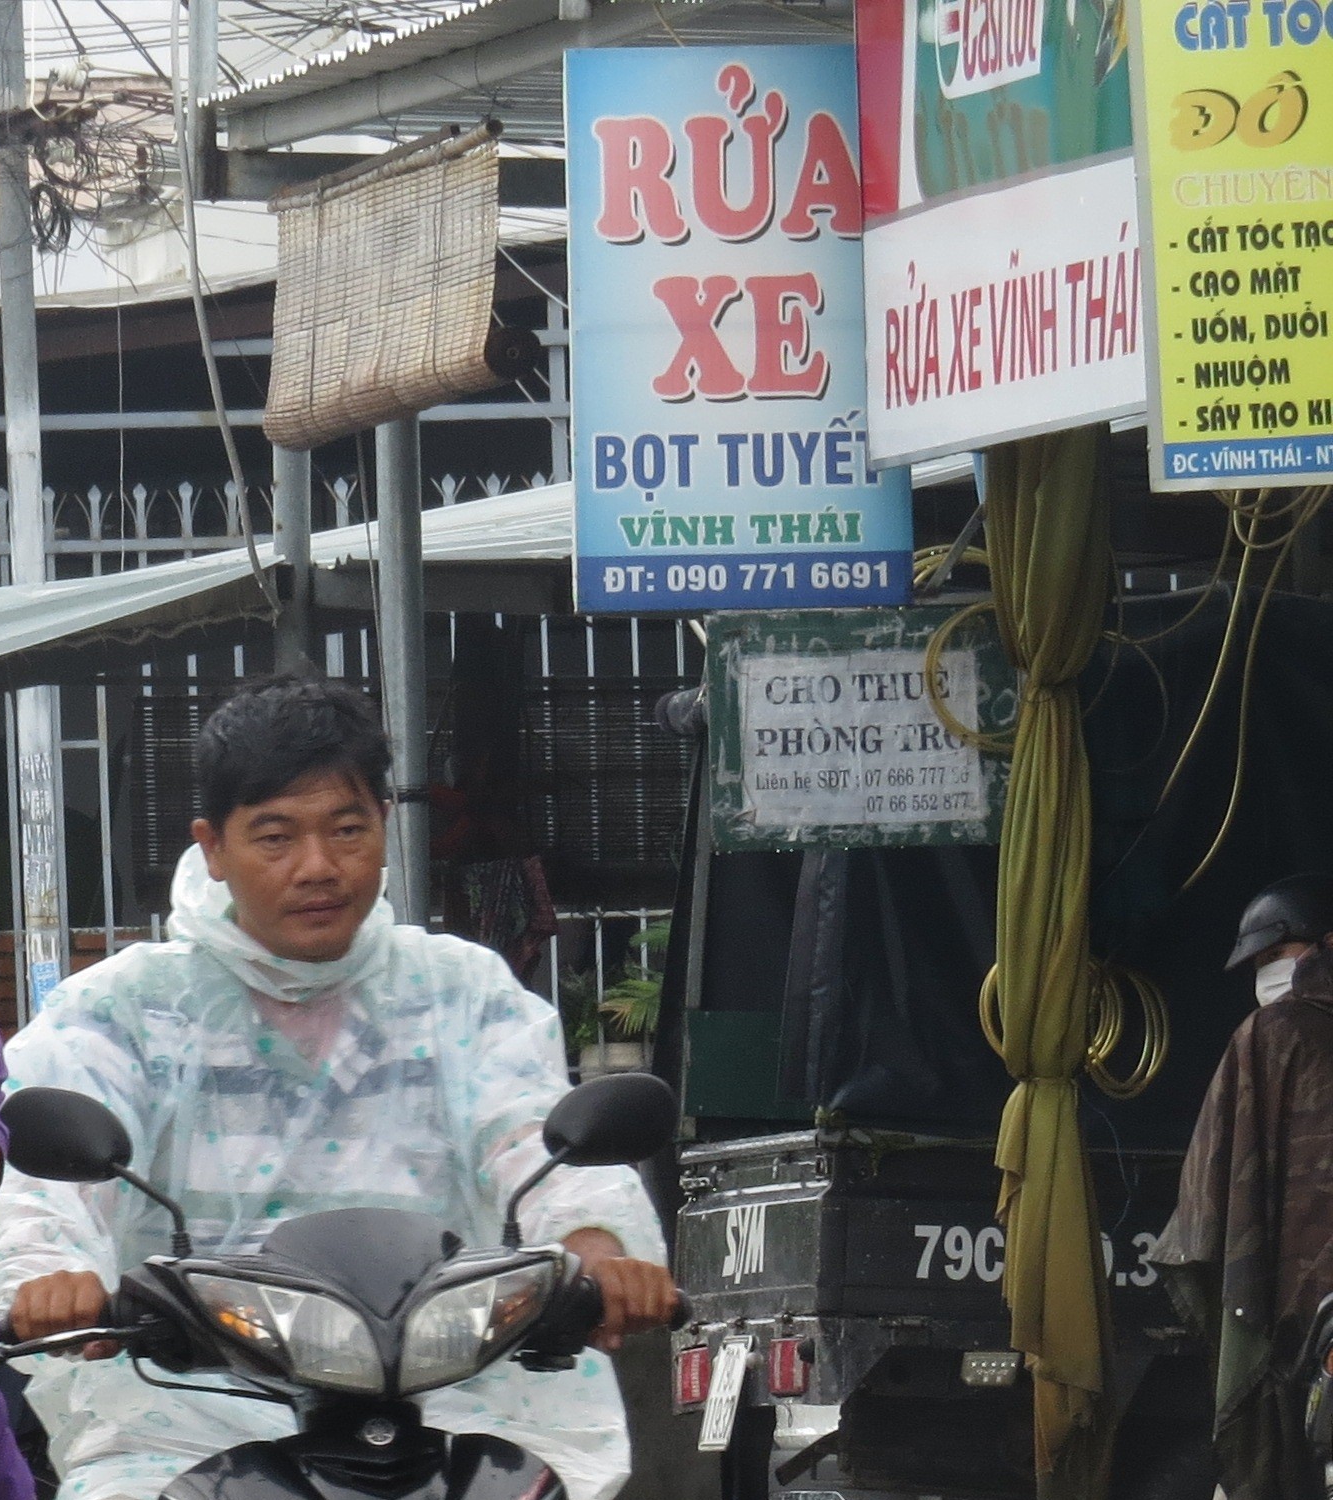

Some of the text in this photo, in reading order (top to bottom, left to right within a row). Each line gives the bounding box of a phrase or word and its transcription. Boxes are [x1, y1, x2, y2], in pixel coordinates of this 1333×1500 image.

[594, 65, 860, 245] RỬA
[1187, 216, 1229, 253] CẮT
[1236, 218, 1284, 251] TÓC
[1189, 269, 1240, 302] CẠO
[1250, 261, 1301, 299] MẶT
[652, 272, 831, 403] XE
[886, 260, 941, 409] RỬA
[947, 286, 982, 395] XE
[989, 249, 1058, 385] VĨNH
[1264, 302, 1328, 340] DUỖI
[1194, 354, 1290, 391] NHUỘM
[1197, 397, 1241, 432] SẤY
[1248, 401, 1298, 434] TẠO
[1308, 398, 1333, 427] KI
[594, 433, 699, 501] BỌT
[1210, 446, 1256, 471] VĨNH
[1259, 443, 1302, 469] THÁI
[619, 506, 862, 547] VĨNH THÁI
[603, 560, 889, 594] ĐT: 090 771 6691
[765, 675, 841, 705] CHO
[755, 716, 882, 758] PHÒNG
[756, 771, 788, 791] Liên
[817, 769, 851, 790] SĐT
[864, 769, 882, 788] 07
[887, 768, 914, 787] 666
[919, 766, 945, 785] 777
[867, 796, 883, 814] 07
[890, 795, 907, 812] 66
[722, 1205, 766, 1285] SYM
[914, 1225, 1005, 1283] 79C
